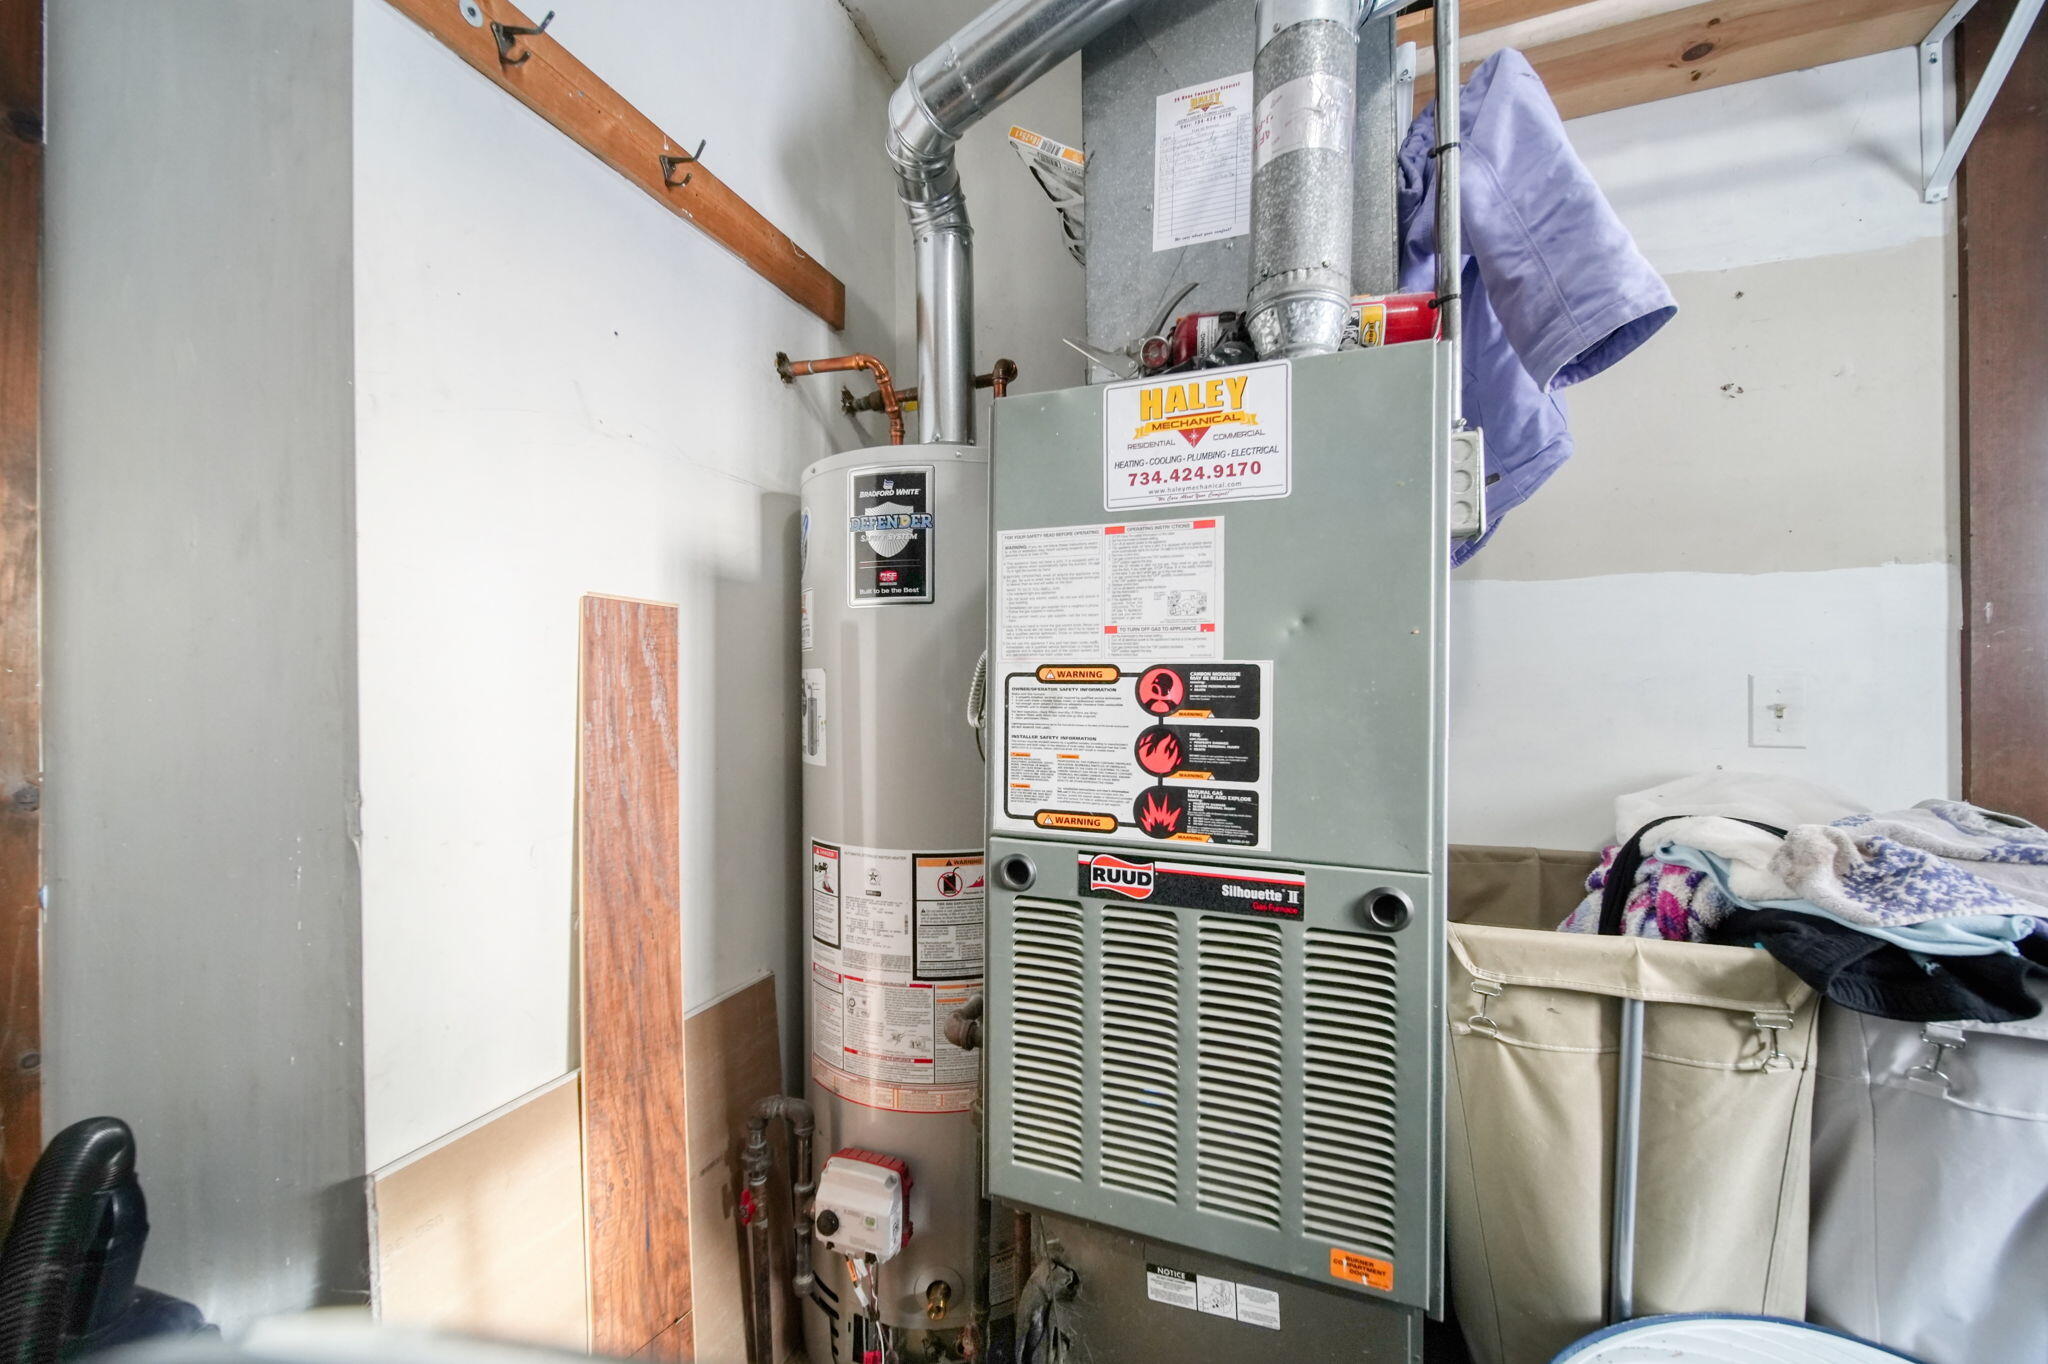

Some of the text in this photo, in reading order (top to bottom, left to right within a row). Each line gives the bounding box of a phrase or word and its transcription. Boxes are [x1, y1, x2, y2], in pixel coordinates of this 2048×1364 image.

[1140, 376, 1248, 421] HALEY
[1152, 414, 1241, 431] MECHANICAL
[1213, 429, 1266, 441] COMMERCIAL
[1127, 440, 1176, 450] RESIDENTIAL
[1114, 445, 1279, 469] HEATING COOLING PLUMBING ELECTRICAL
[1128, 461, 1262, 487] 734.424.9170
[859, 488, 920, 498] BRADFORD WHITE
[1148, 481, 1242, 494] www.haleymechanical.com
[850, 512, 933, 532] DEFENDER
[1057, 670, 1103, 679] WARNING
[1055, 816, 1101, 827] WARNING
[1092, 867, 1152, 887] RUUD
[1221, 884, 1300, 904] Silhouette II
[1252, 901, 1299, 914] Gas Furnace
[1345, 1256, 1374, 1267] BURNER
[1157, 1267, 1185, 1280] NOTICE
